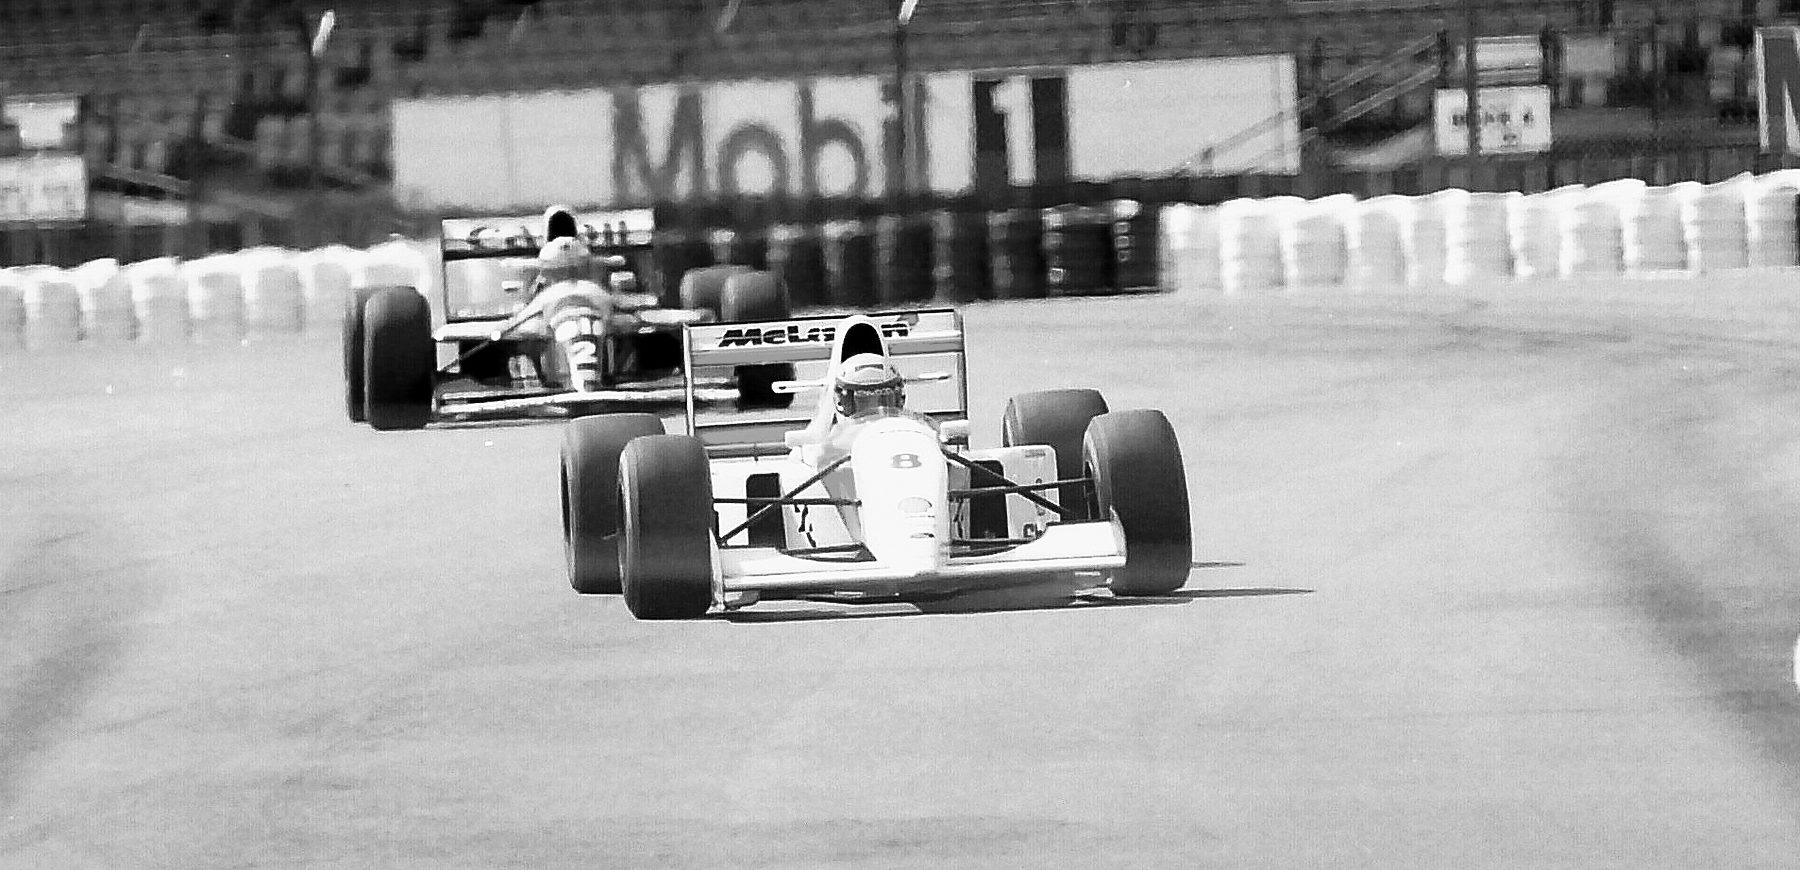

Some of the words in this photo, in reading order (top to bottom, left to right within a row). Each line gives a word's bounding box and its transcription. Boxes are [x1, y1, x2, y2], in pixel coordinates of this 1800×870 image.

[612, 80, 927, 202] Mobil
[990, 76, 1037, 187] 1
[718, 323, 909, 347] McLan
[892, 453, 922, 469] 8
